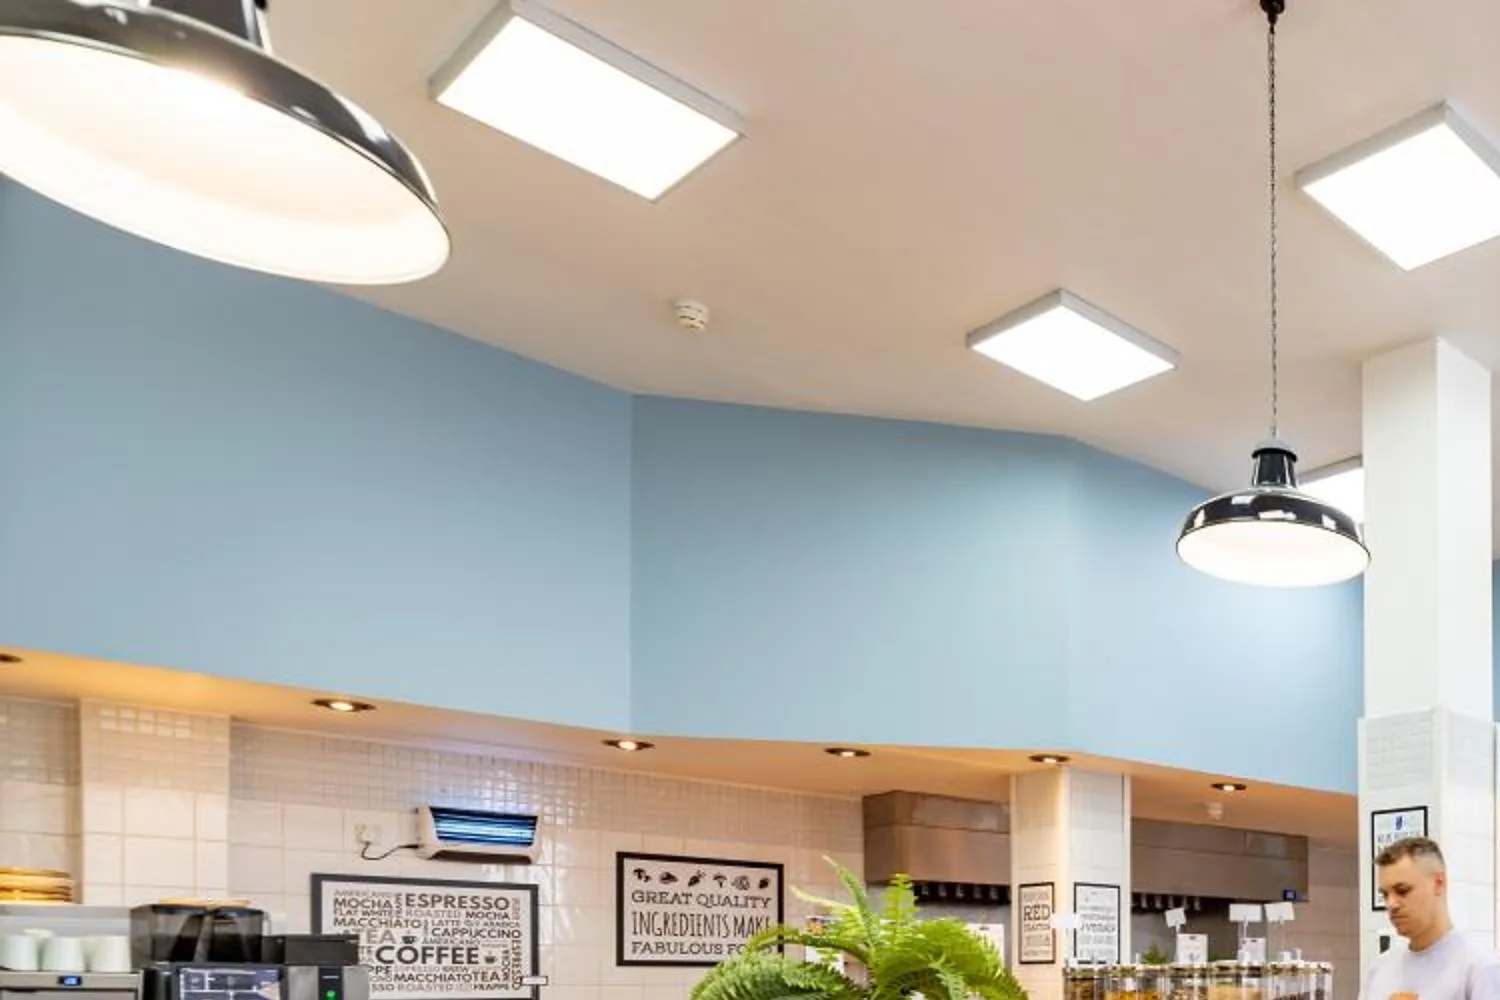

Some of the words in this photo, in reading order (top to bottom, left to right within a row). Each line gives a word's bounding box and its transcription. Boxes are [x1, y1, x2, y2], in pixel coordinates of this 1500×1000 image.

[333, 898, 392, 909] MOCHA
[405, 893, 509, 911] ESPRESSO
[631, 889, 692, 905] GREAT
[696, 893, 772, 909] QUALITY
[465, 911, 509, 921] MOCHA
[1023, 904, 1051, 921] RED
[333, 917, 421, 929] MACCHIATO
[431, 919, 460, 927] LATTE
[631, 911, 730, 938] INGREDIENTS
[431, 927, 521, 939] CAPPUCCINO
[631, 941, 722, 956] FABULOUS
[375, 945, 479, 965] COFFEE
[394, 973, 473, 982] MACCHIATO
[472, 971, 501, 983] TEA
